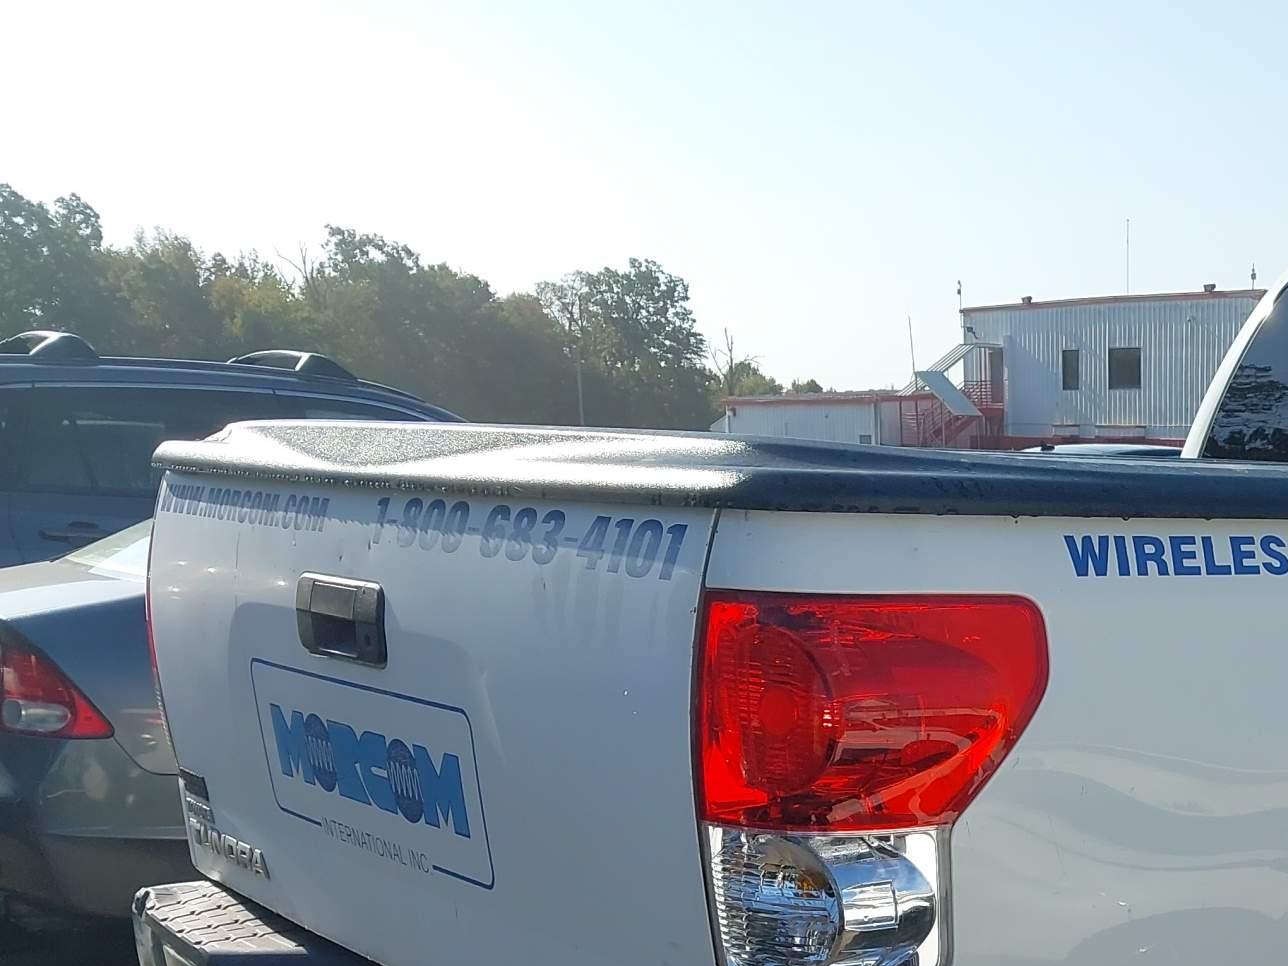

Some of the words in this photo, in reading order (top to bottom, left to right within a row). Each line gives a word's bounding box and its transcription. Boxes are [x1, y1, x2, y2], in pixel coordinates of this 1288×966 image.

[160, 484, 331, 532] WWW.MORCOM.COM
[373, 496, 689, 581] 1-800-683-4101
[268, 702, 472, 840] MORCOM
[189, 816, 271, 881] TUNDRA
[322, 816, 408, 866] INTERNATIONAL
